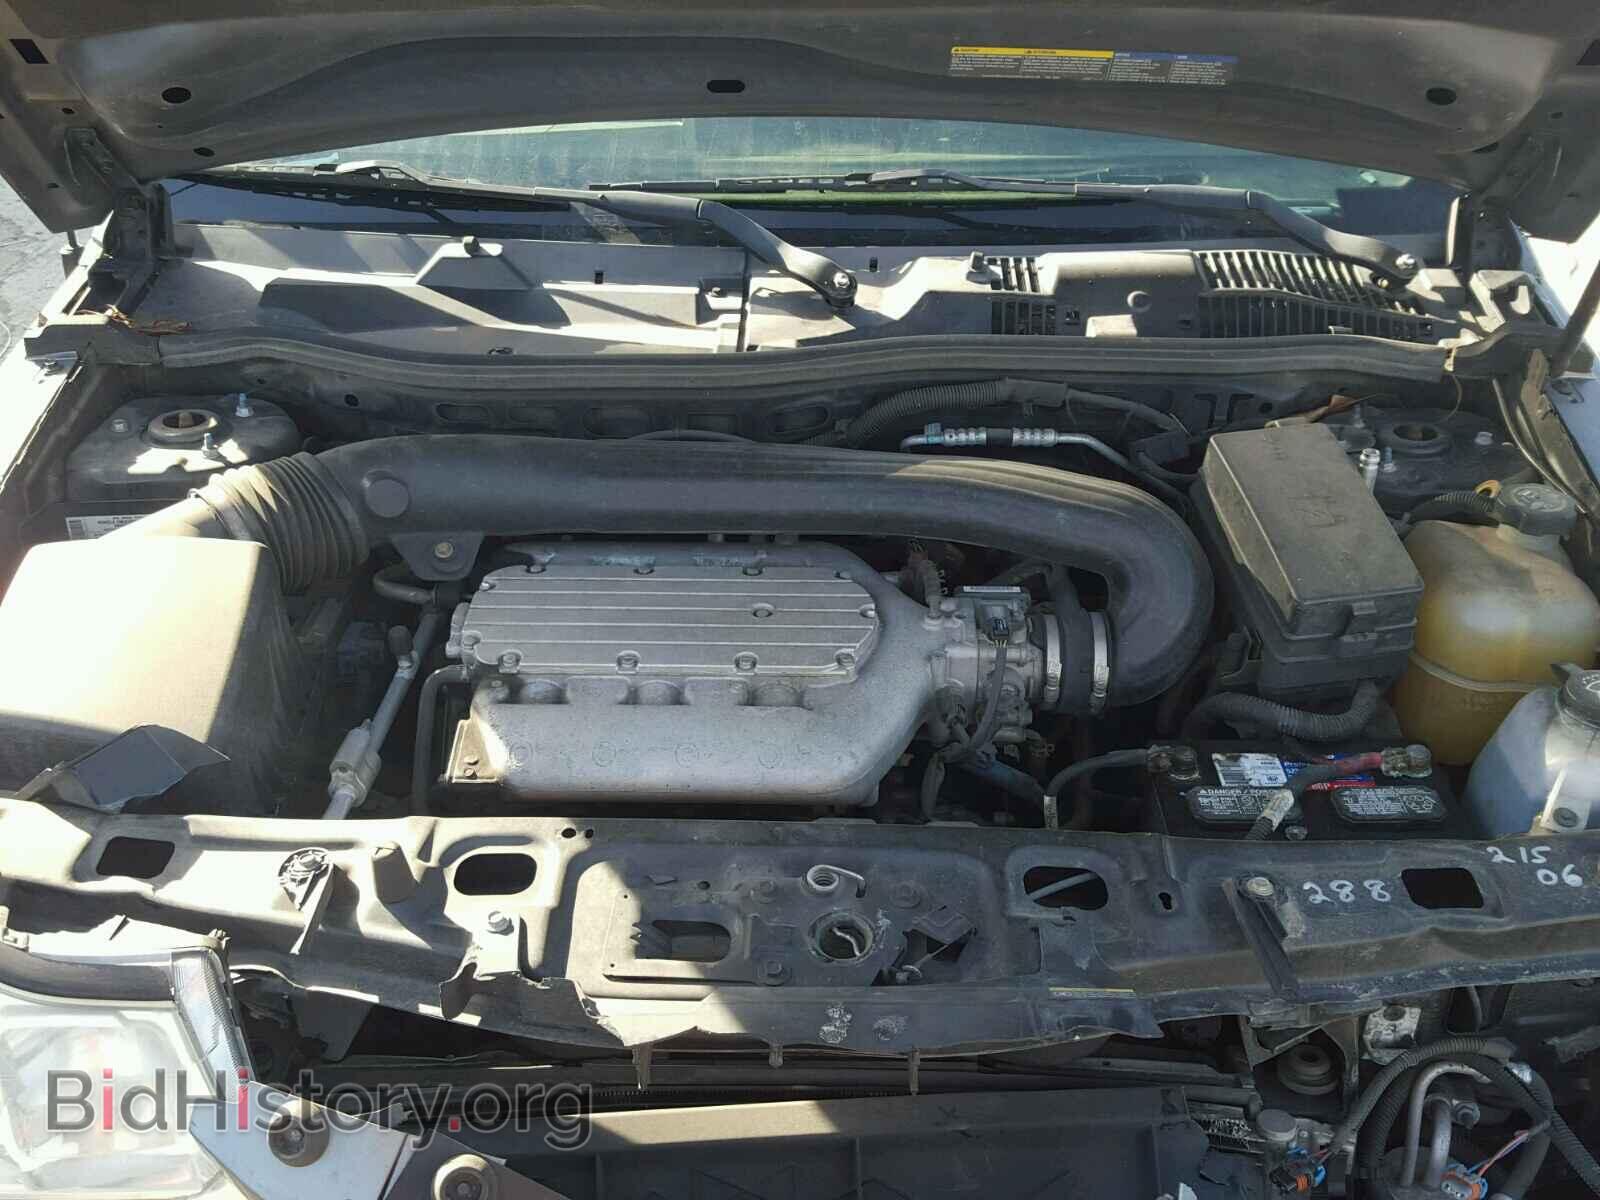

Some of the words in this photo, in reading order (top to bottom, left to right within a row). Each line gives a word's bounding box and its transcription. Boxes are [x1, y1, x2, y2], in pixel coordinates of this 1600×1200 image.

[1486, 846, 1552, 864] 215
[1536, 864, 1584, 887] 06
[1302, 879, 1391, 904] 288
